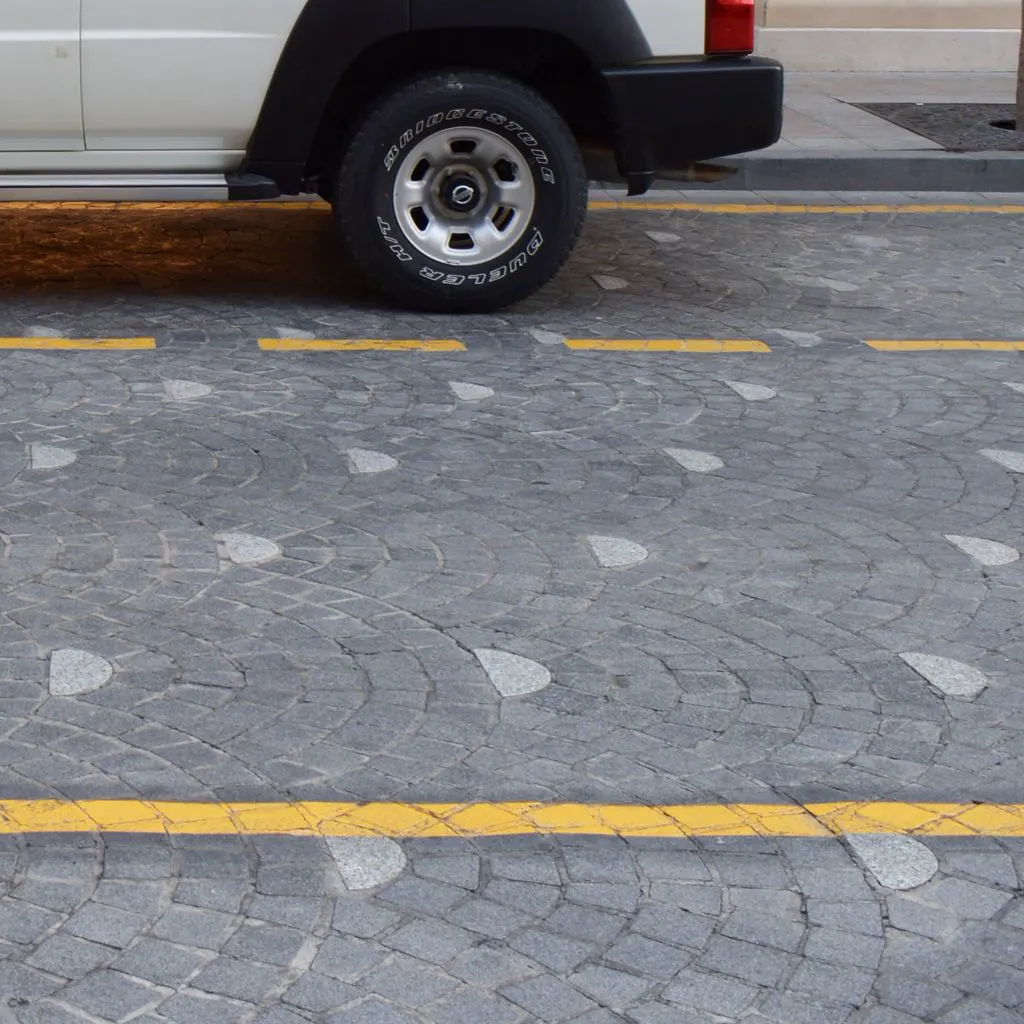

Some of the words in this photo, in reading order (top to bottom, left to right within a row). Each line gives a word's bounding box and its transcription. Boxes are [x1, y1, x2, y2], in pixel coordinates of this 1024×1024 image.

[383, 107, 556, 186] BRIDGESTONE
[376, 215, 414, 263] H/T
[418, 230, 545, 286] DUELER
